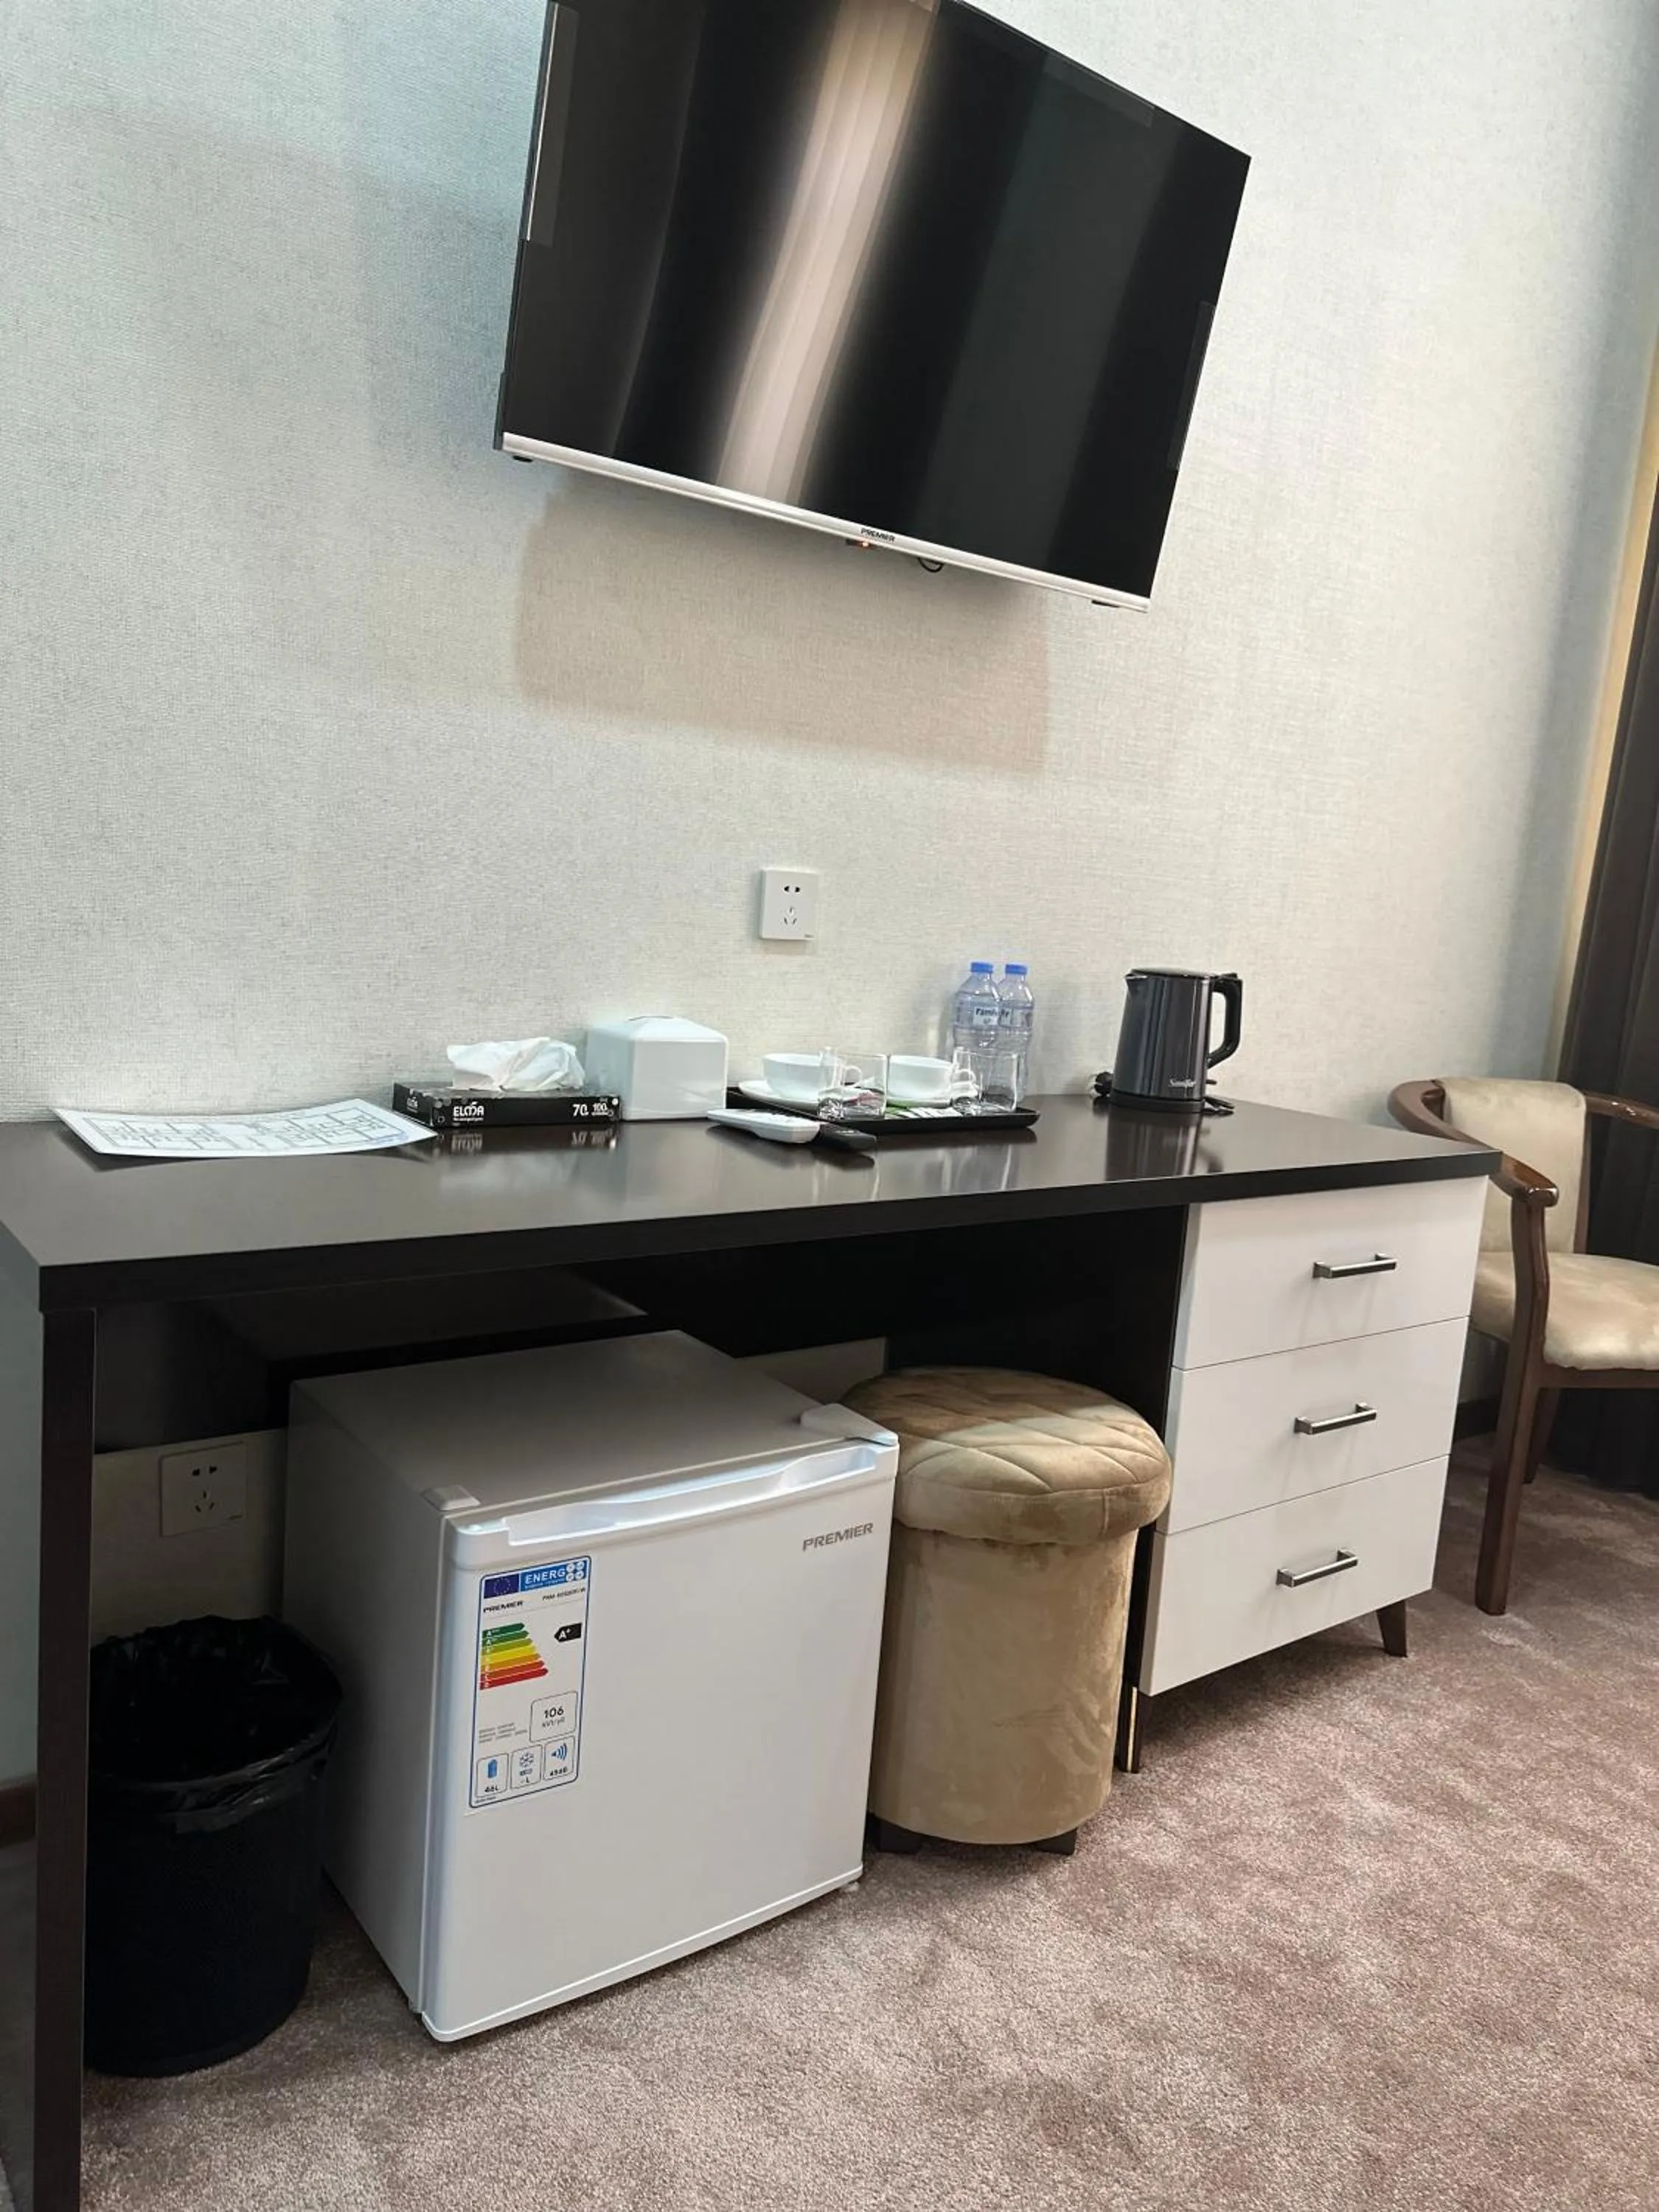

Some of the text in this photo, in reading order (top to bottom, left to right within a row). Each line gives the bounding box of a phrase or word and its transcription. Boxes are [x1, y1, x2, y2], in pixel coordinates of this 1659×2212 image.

[860, 527, 896, 542] PREMIER
[802, 1523, 874, 1551] PREMIER
[524, 1568, 566, 1585] ENERG
[483, 1600, 524, 1613] PREMIER
[543, 1705, 565, 1719] 106
